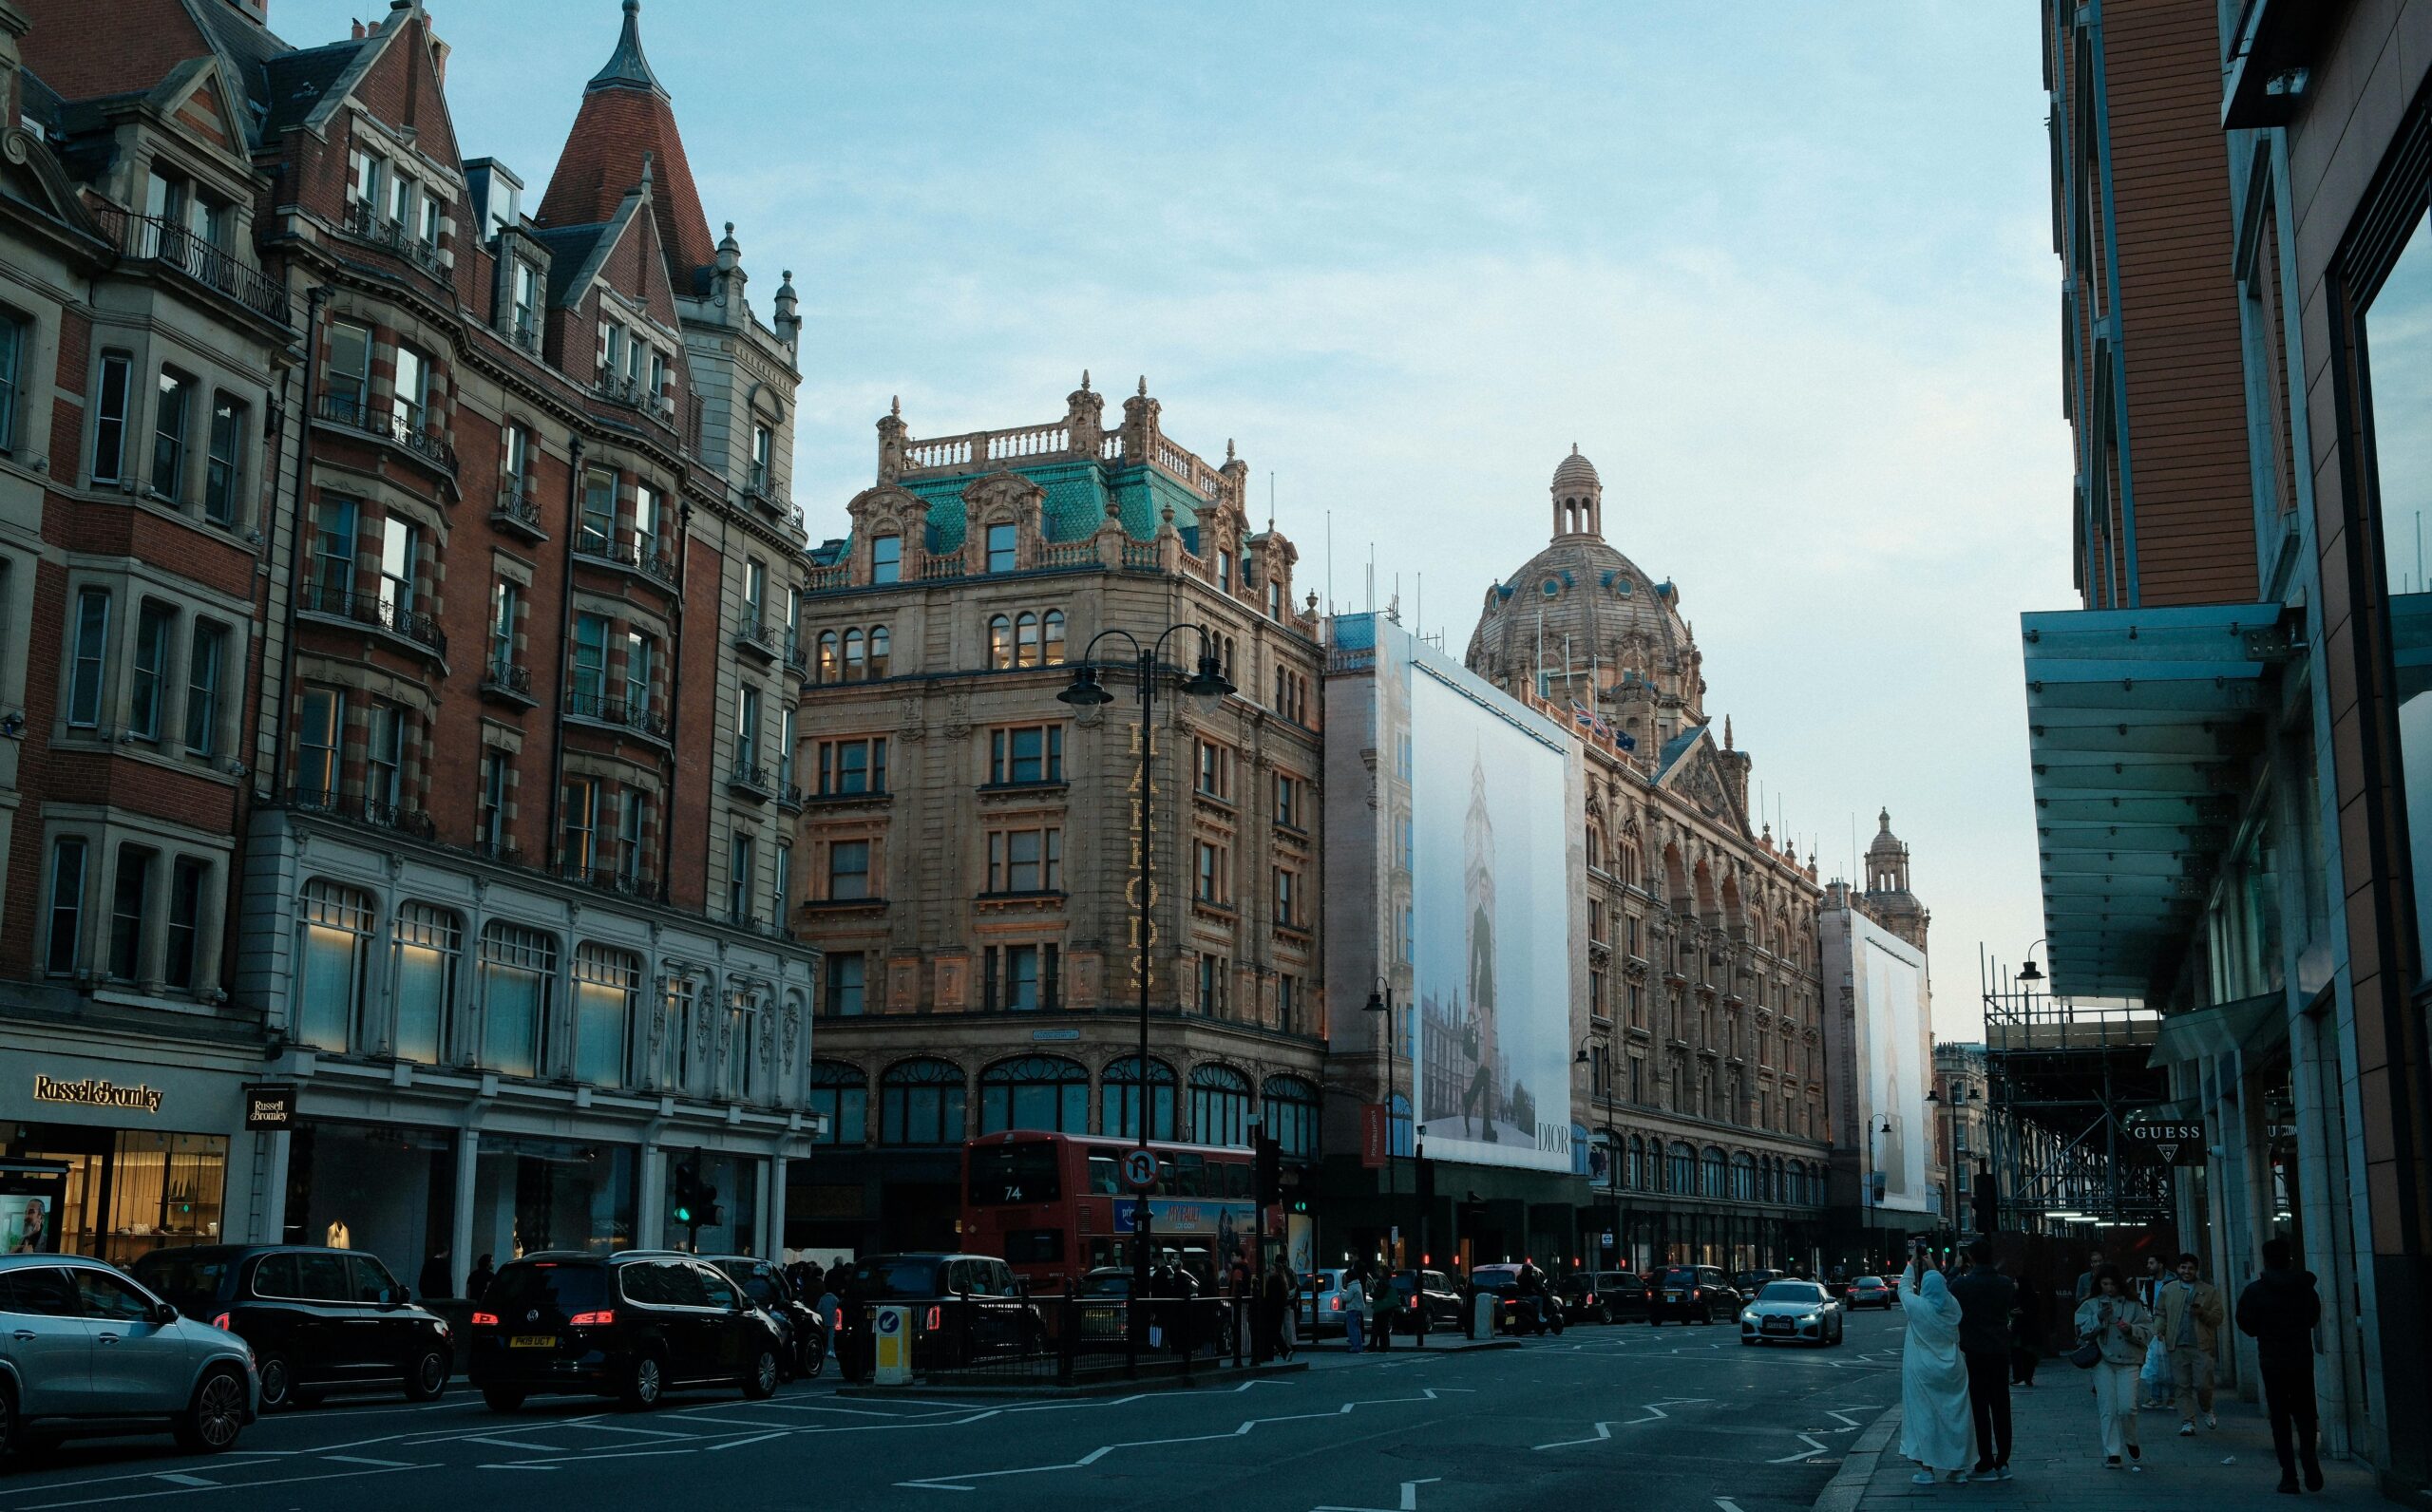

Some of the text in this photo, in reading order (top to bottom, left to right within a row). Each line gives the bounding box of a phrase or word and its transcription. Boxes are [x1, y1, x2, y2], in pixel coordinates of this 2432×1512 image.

[1126, 723, 1159, 989] HARRODS
[255, 1101, 284, 1111] Russell
[1537, 1122, 1569, 1155] DIOR
[2135, 1125, 2200, 1139] GUESS
[1005, 1186, 1022, 1200] 74
